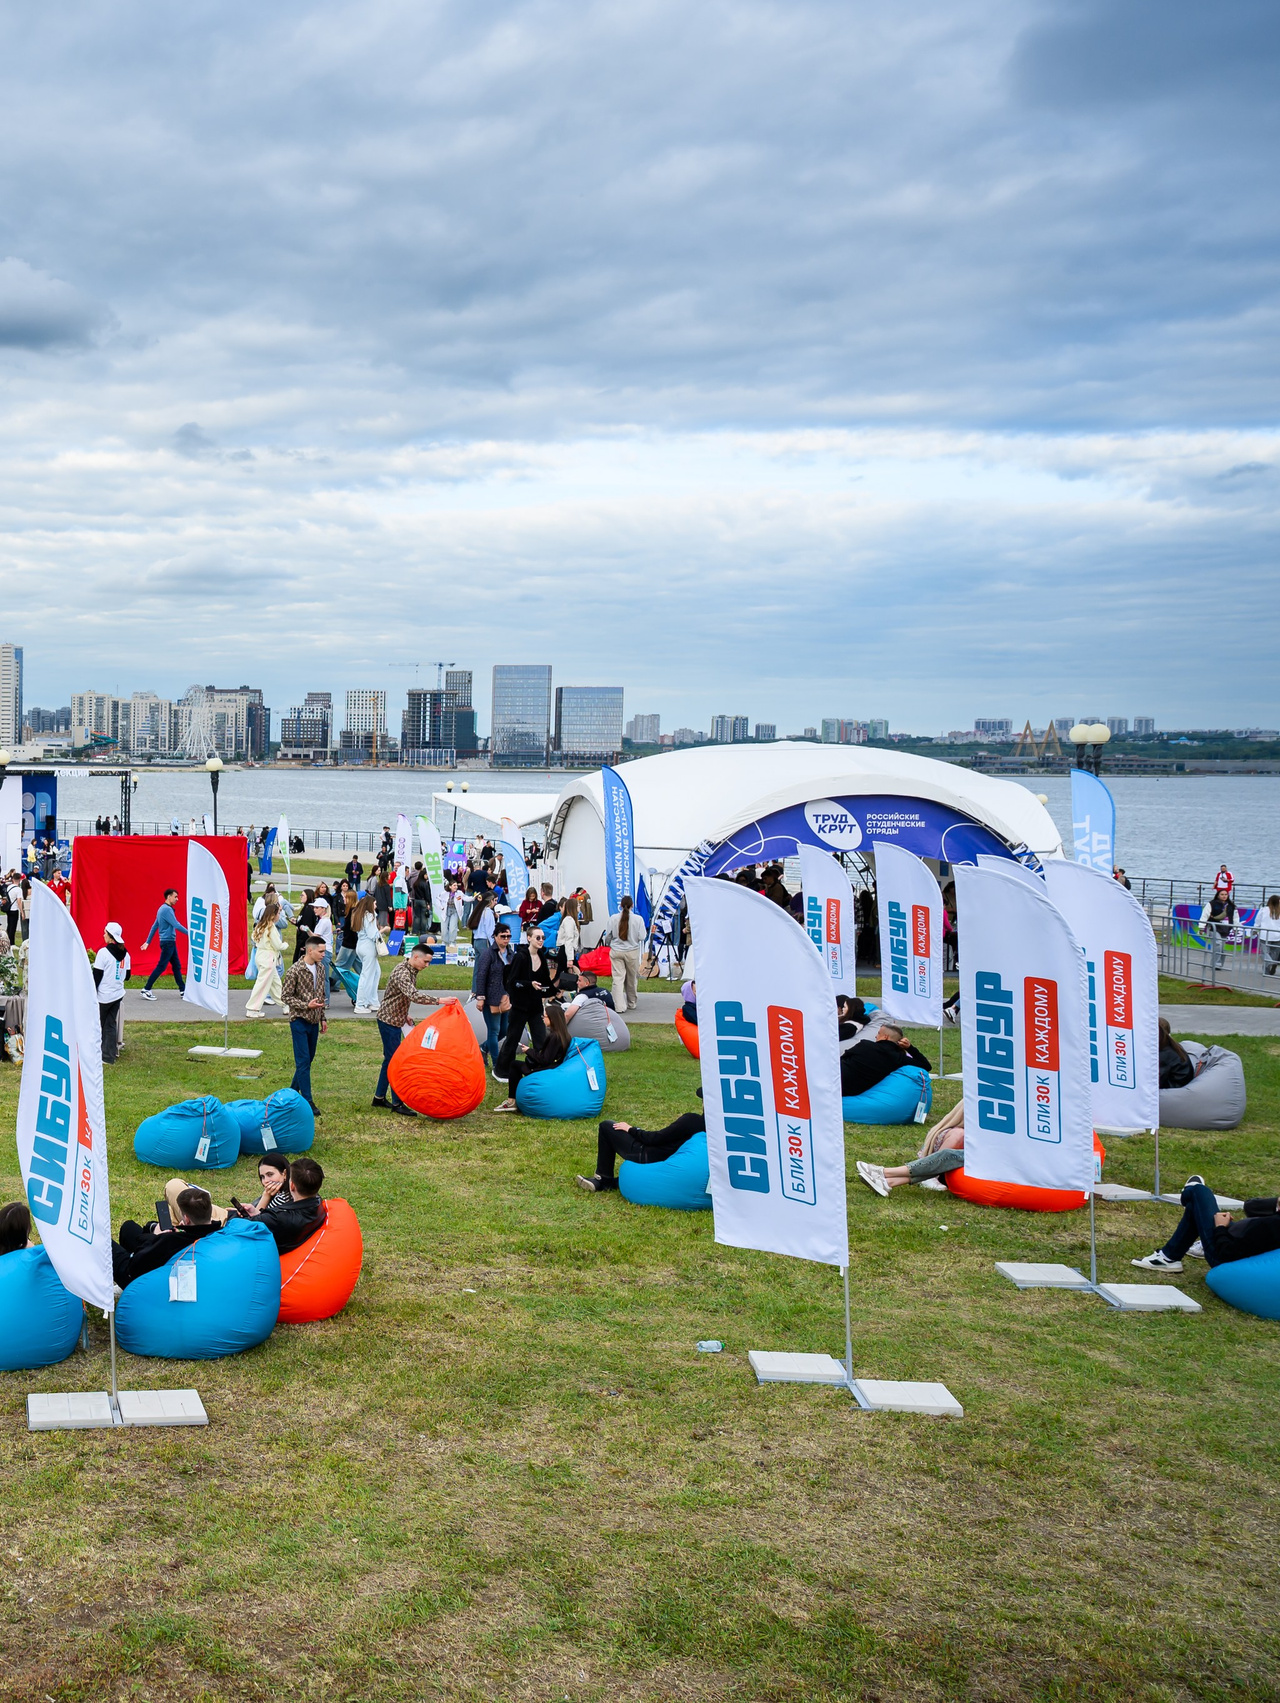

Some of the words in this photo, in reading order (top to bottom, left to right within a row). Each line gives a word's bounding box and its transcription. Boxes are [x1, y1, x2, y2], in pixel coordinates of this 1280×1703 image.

[812, 814, 848, 824] ТРУД
[817, 824, 856, 834] КРУТ
[866, 812, 920, 820] РОССИЙСКИЕ
[190, 897, 207, 983] СИБУР
[807, 896, 822, 956] БУР
[888, 901, 908, 993] СИБУР
[917, 909, 926, 953] КАЖДОМУ
[1033, 983, 1051, 1063] КАЖДОМУ
[1112, 956, 1126, 1023] КАЖДОМУ
[778, 1014, 800, 1110] КАЖДОМУ
[975, 970, 1015, 1134] СИБУР
[27, 1014, 70, 1226] СИБУР
[714, 1001, 770, 1194] СИБУР
